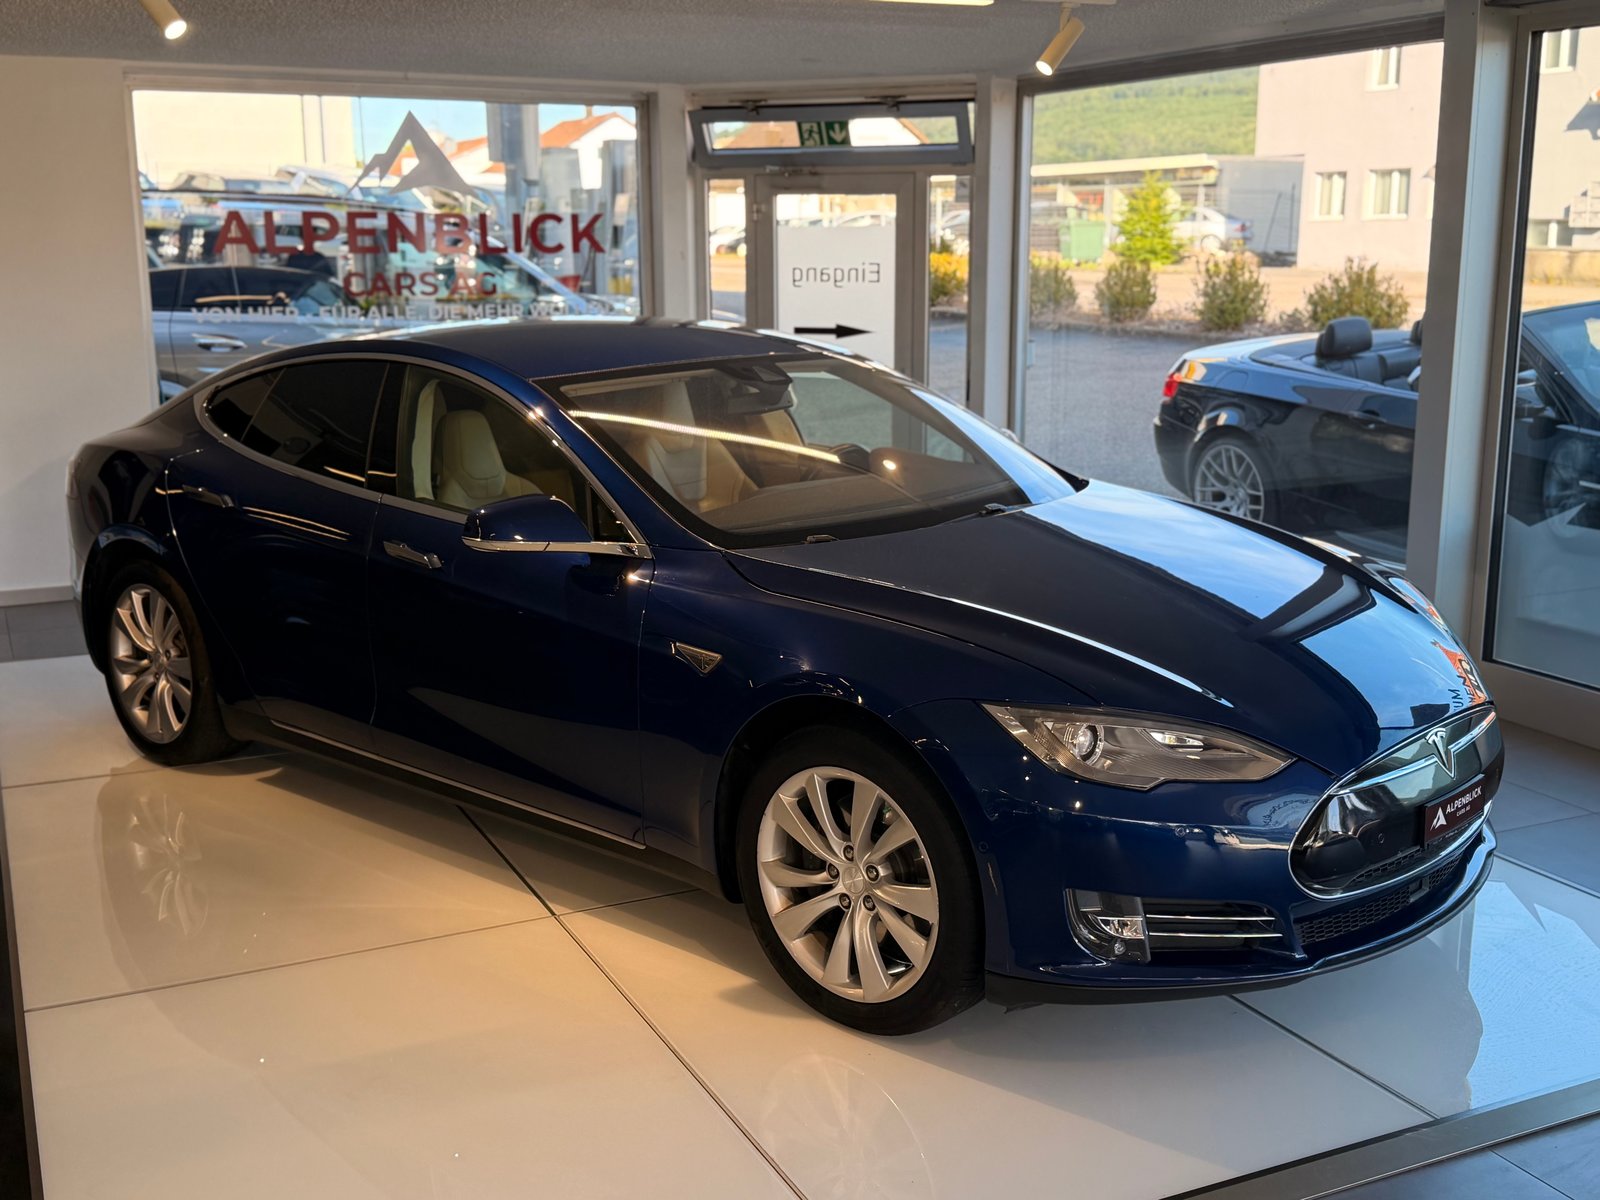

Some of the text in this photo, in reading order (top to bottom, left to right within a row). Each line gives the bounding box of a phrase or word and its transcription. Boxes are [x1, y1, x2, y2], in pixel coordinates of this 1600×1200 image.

[213, 210, 605, 255] ALPENBLICK
[343, 271, 498, 298] CARS AG
[191, 305, 242, 324] VON
[319, 301, 361, 320] FÜR
[428, 303, 462, 320] DIE
[467, 302, 523, 319] MEHR
[1445, 785, 1482, 815] ALPENBLICK
